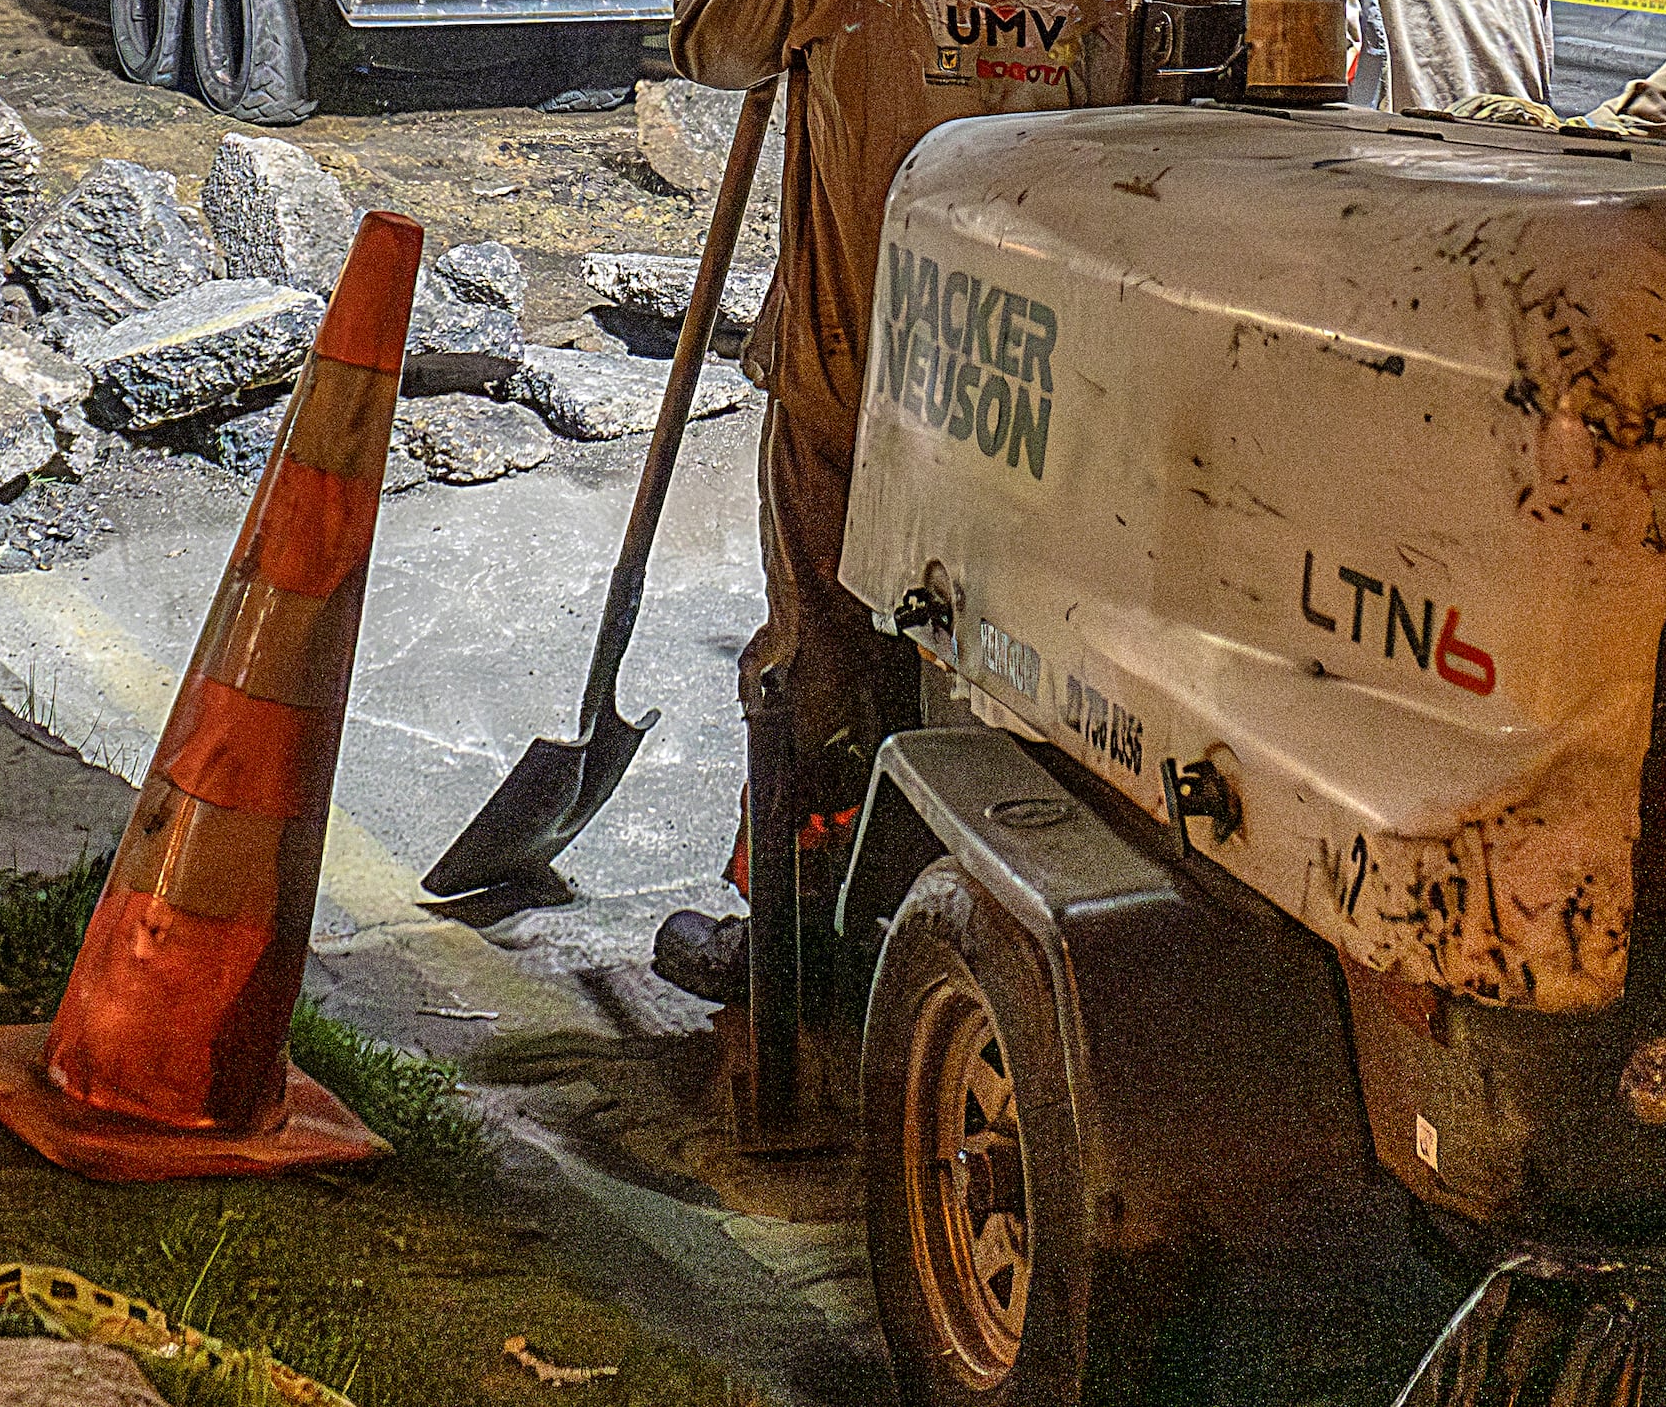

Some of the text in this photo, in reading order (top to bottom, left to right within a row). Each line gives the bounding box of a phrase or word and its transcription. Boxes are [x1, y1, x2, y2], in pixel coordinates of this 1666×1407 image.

[946, 4, 1068, 52] UMV
[887, 242, 1059, 394] WACKER
[876, 319, 1053, 481] NEUSON
[1301, 549, 1495, 696] LTN6
